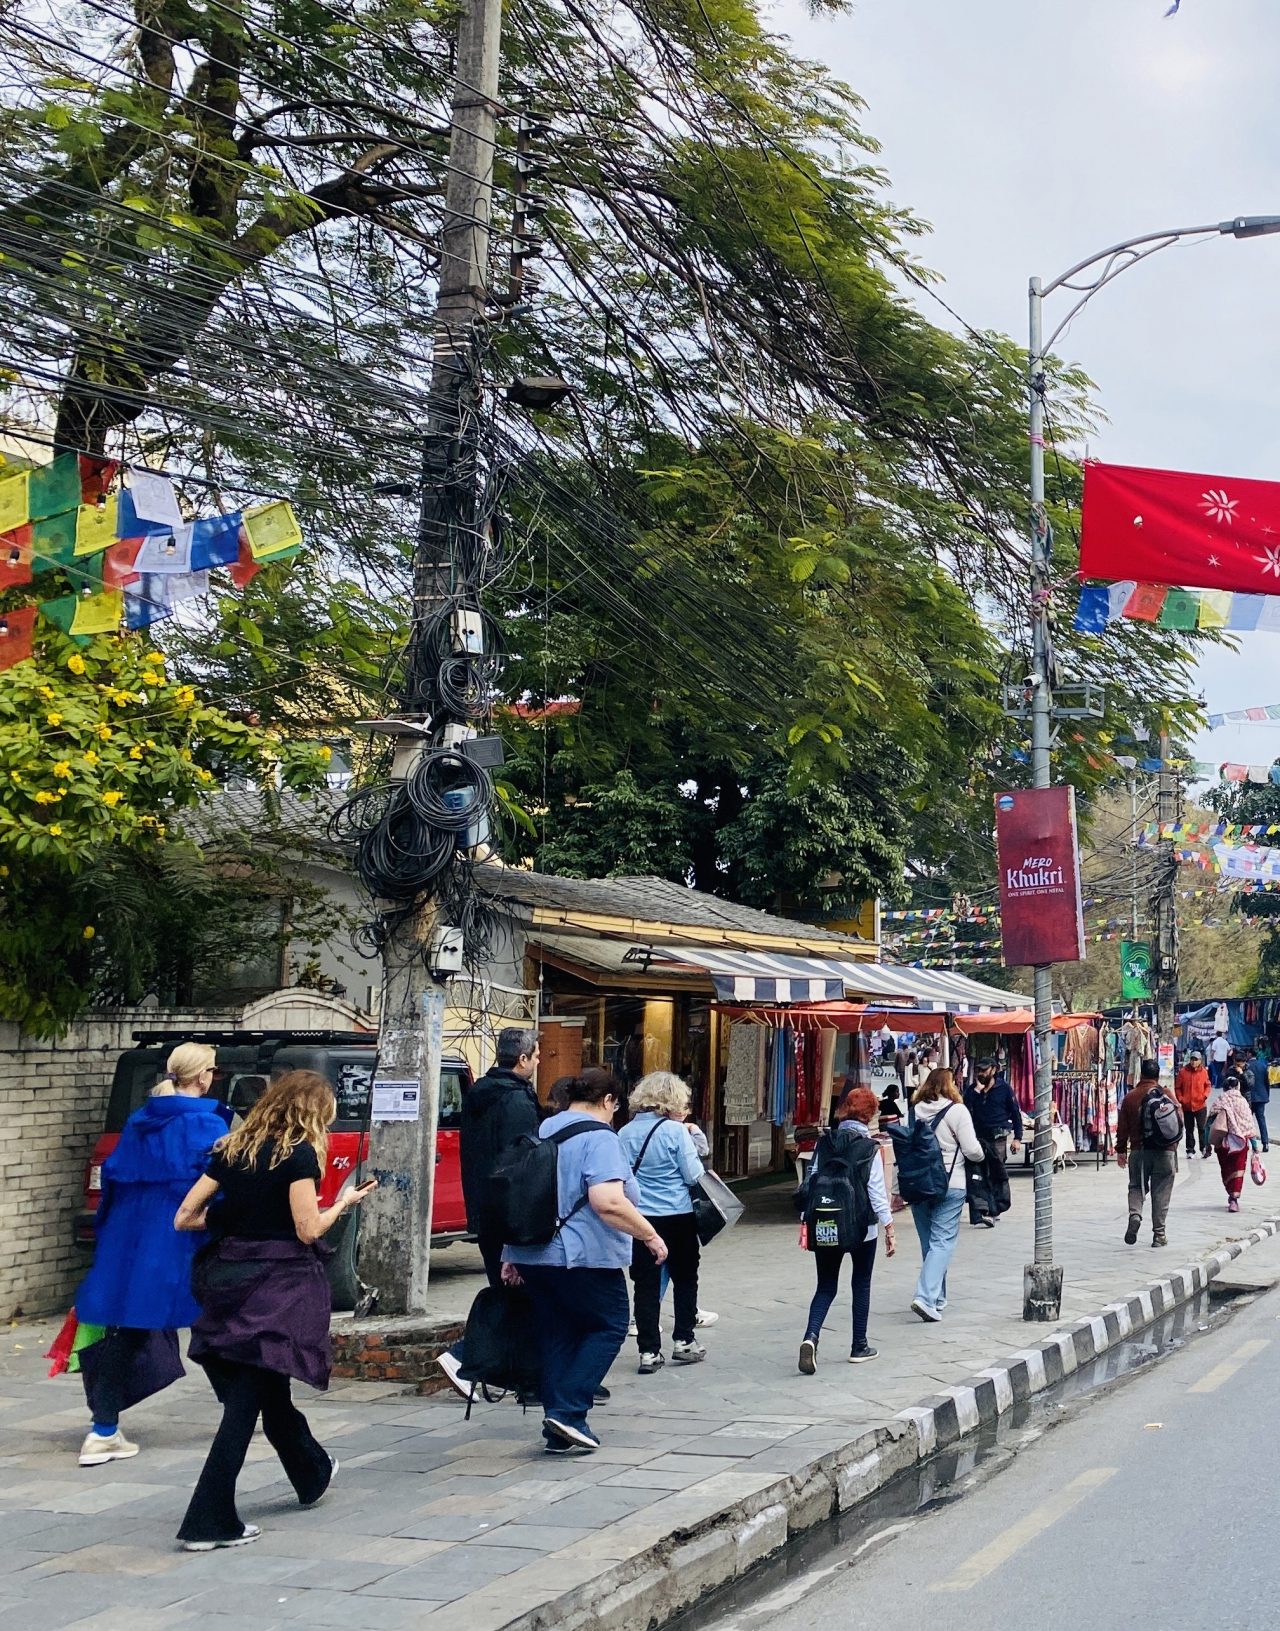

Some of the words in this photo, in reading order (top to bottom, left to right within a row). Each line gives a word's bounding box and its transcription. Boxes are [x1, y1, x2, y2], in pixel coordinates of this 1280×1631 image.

[1023, 857, 1053, 869] MERO
[1007, 866, 1064, 889] Khukri
[815, 1226, 838, 1236] RUN
